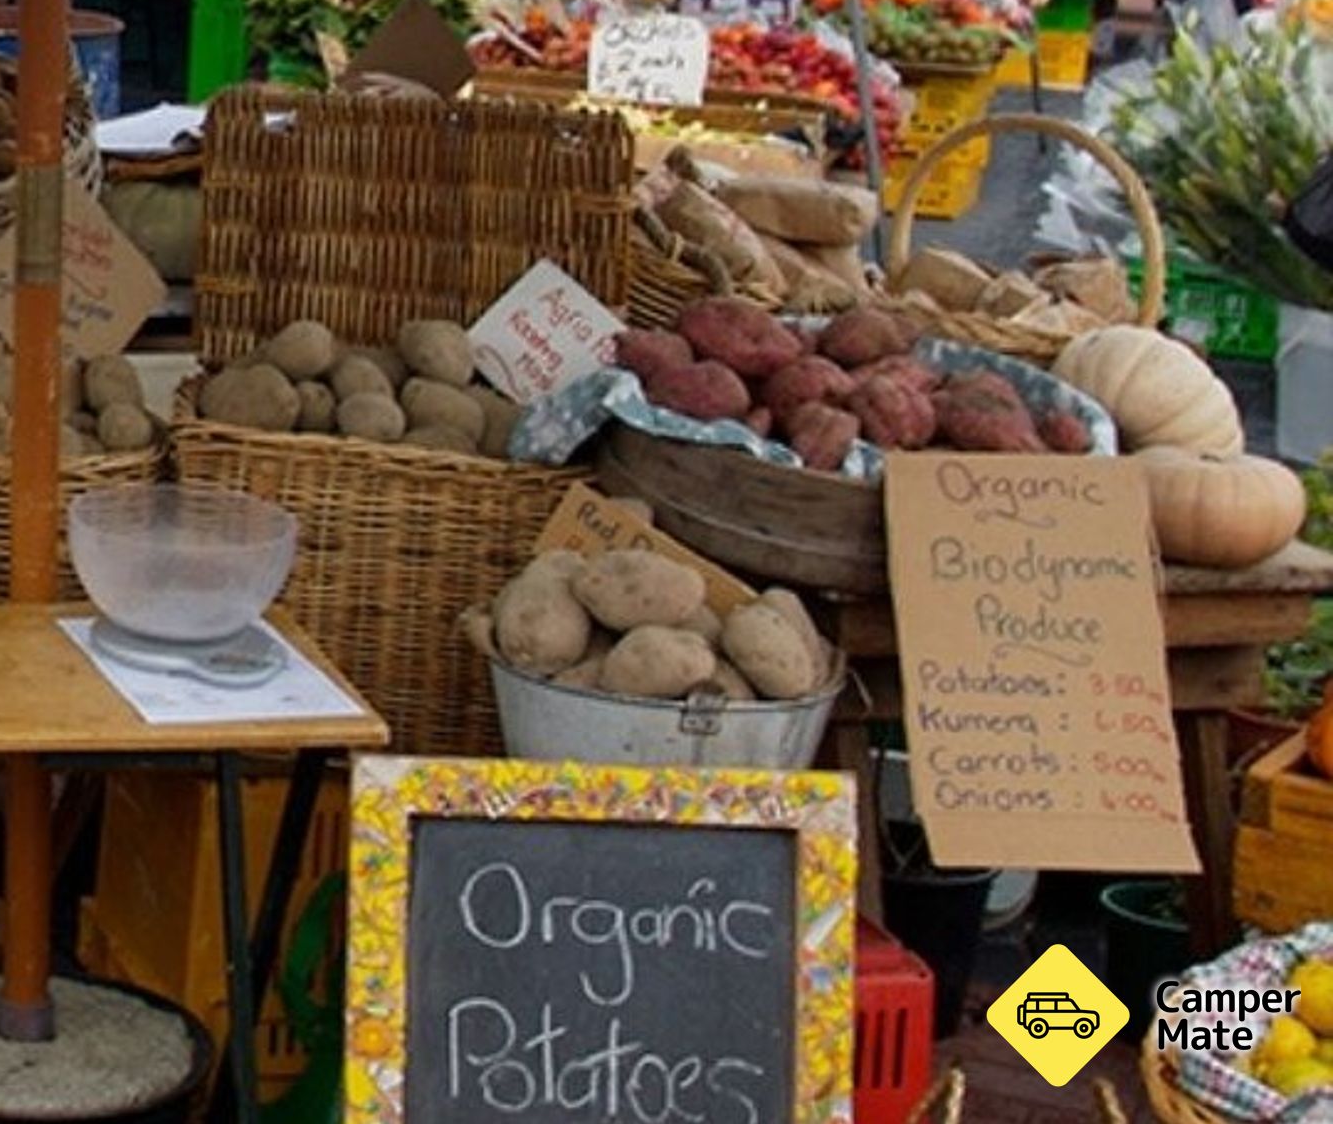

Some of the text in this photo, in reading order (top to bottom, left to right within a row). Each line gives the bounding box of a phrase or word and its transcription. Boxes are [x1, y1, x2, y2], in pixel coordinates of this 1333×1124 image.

[935, 459, 1106, 518] Organic
[930, 535, 1138, 604] Biodynamic
[974, 593, 1103, 644] Produce
[459, 861, 772, 1006] Organic
[448, 996, 764, 1124] Potatoes
